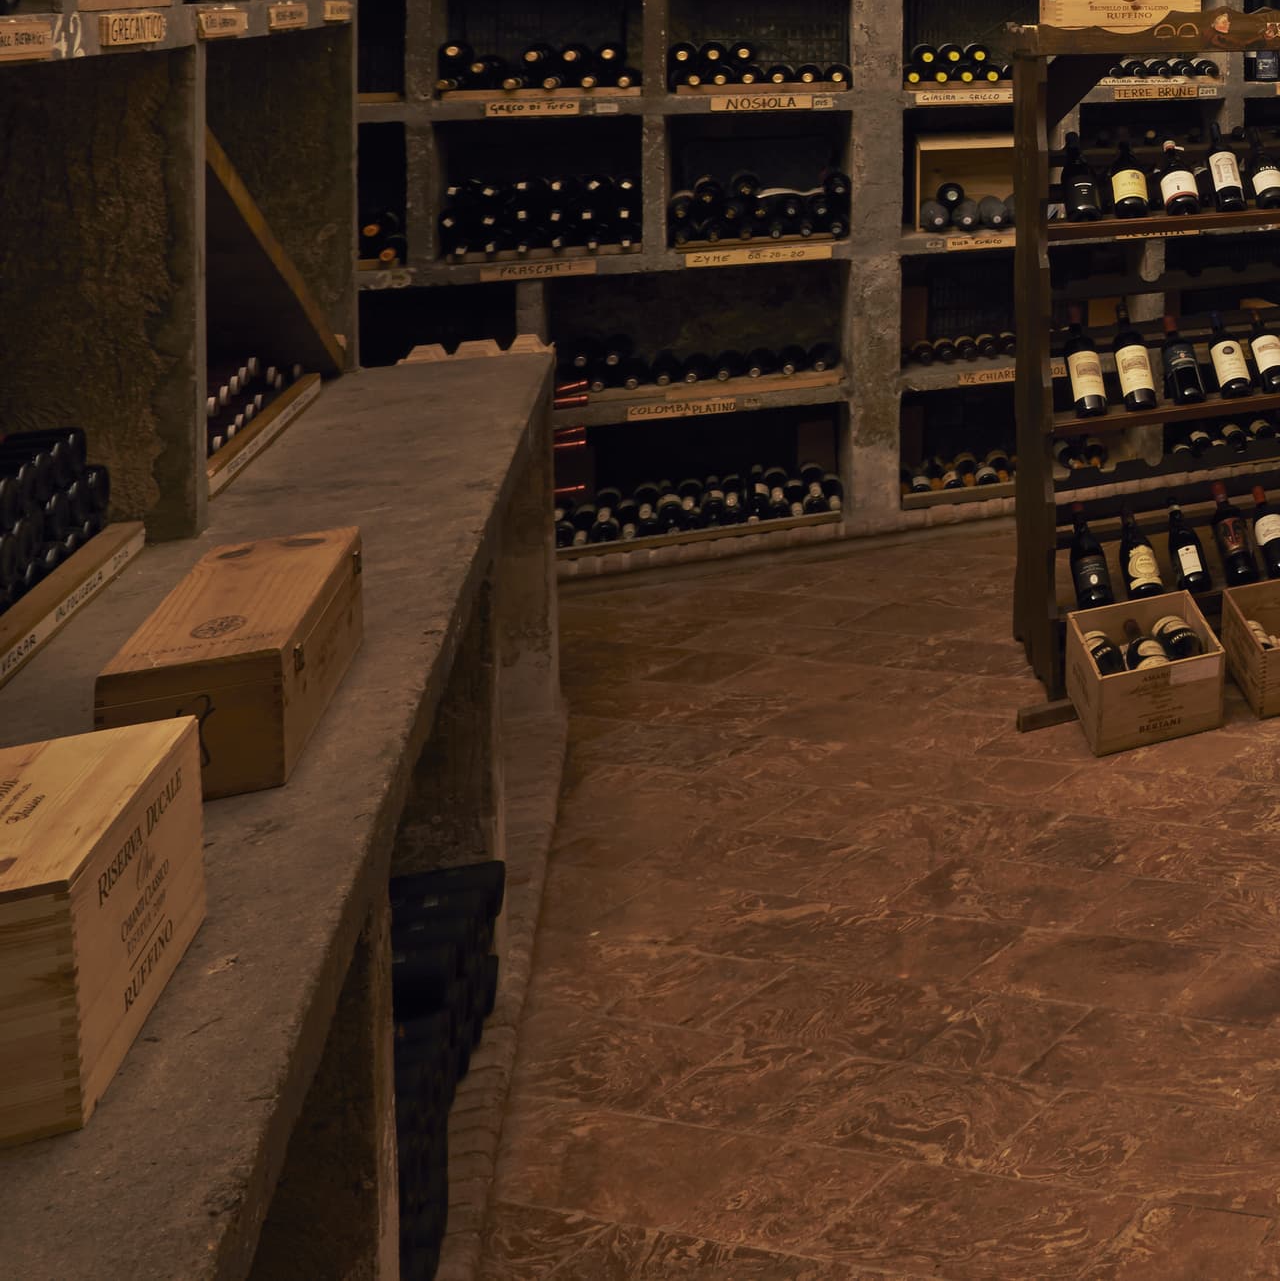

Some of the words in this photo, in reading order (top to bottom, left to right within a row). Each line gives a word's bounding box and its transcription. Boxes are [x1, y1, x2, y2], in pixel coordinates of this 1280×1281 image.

[1106, 12, 1153, 20] RUFFINO
[53, 12, 86, 58] 42
[1117, 87, 1154, 99] TERRE
[1158, 86, 1197, 98] BRUNE
[725, 98, 797, 110] NOSIOLA
[629, 403, 691, 417] COLOMBA
[1138, 717, 1182, 733] BERTANI
[98, 827, 144, 906] RISERVA
[145, 767, 182, 828] DUCALE
[123, 921, 174, 1014] RUFFINO
